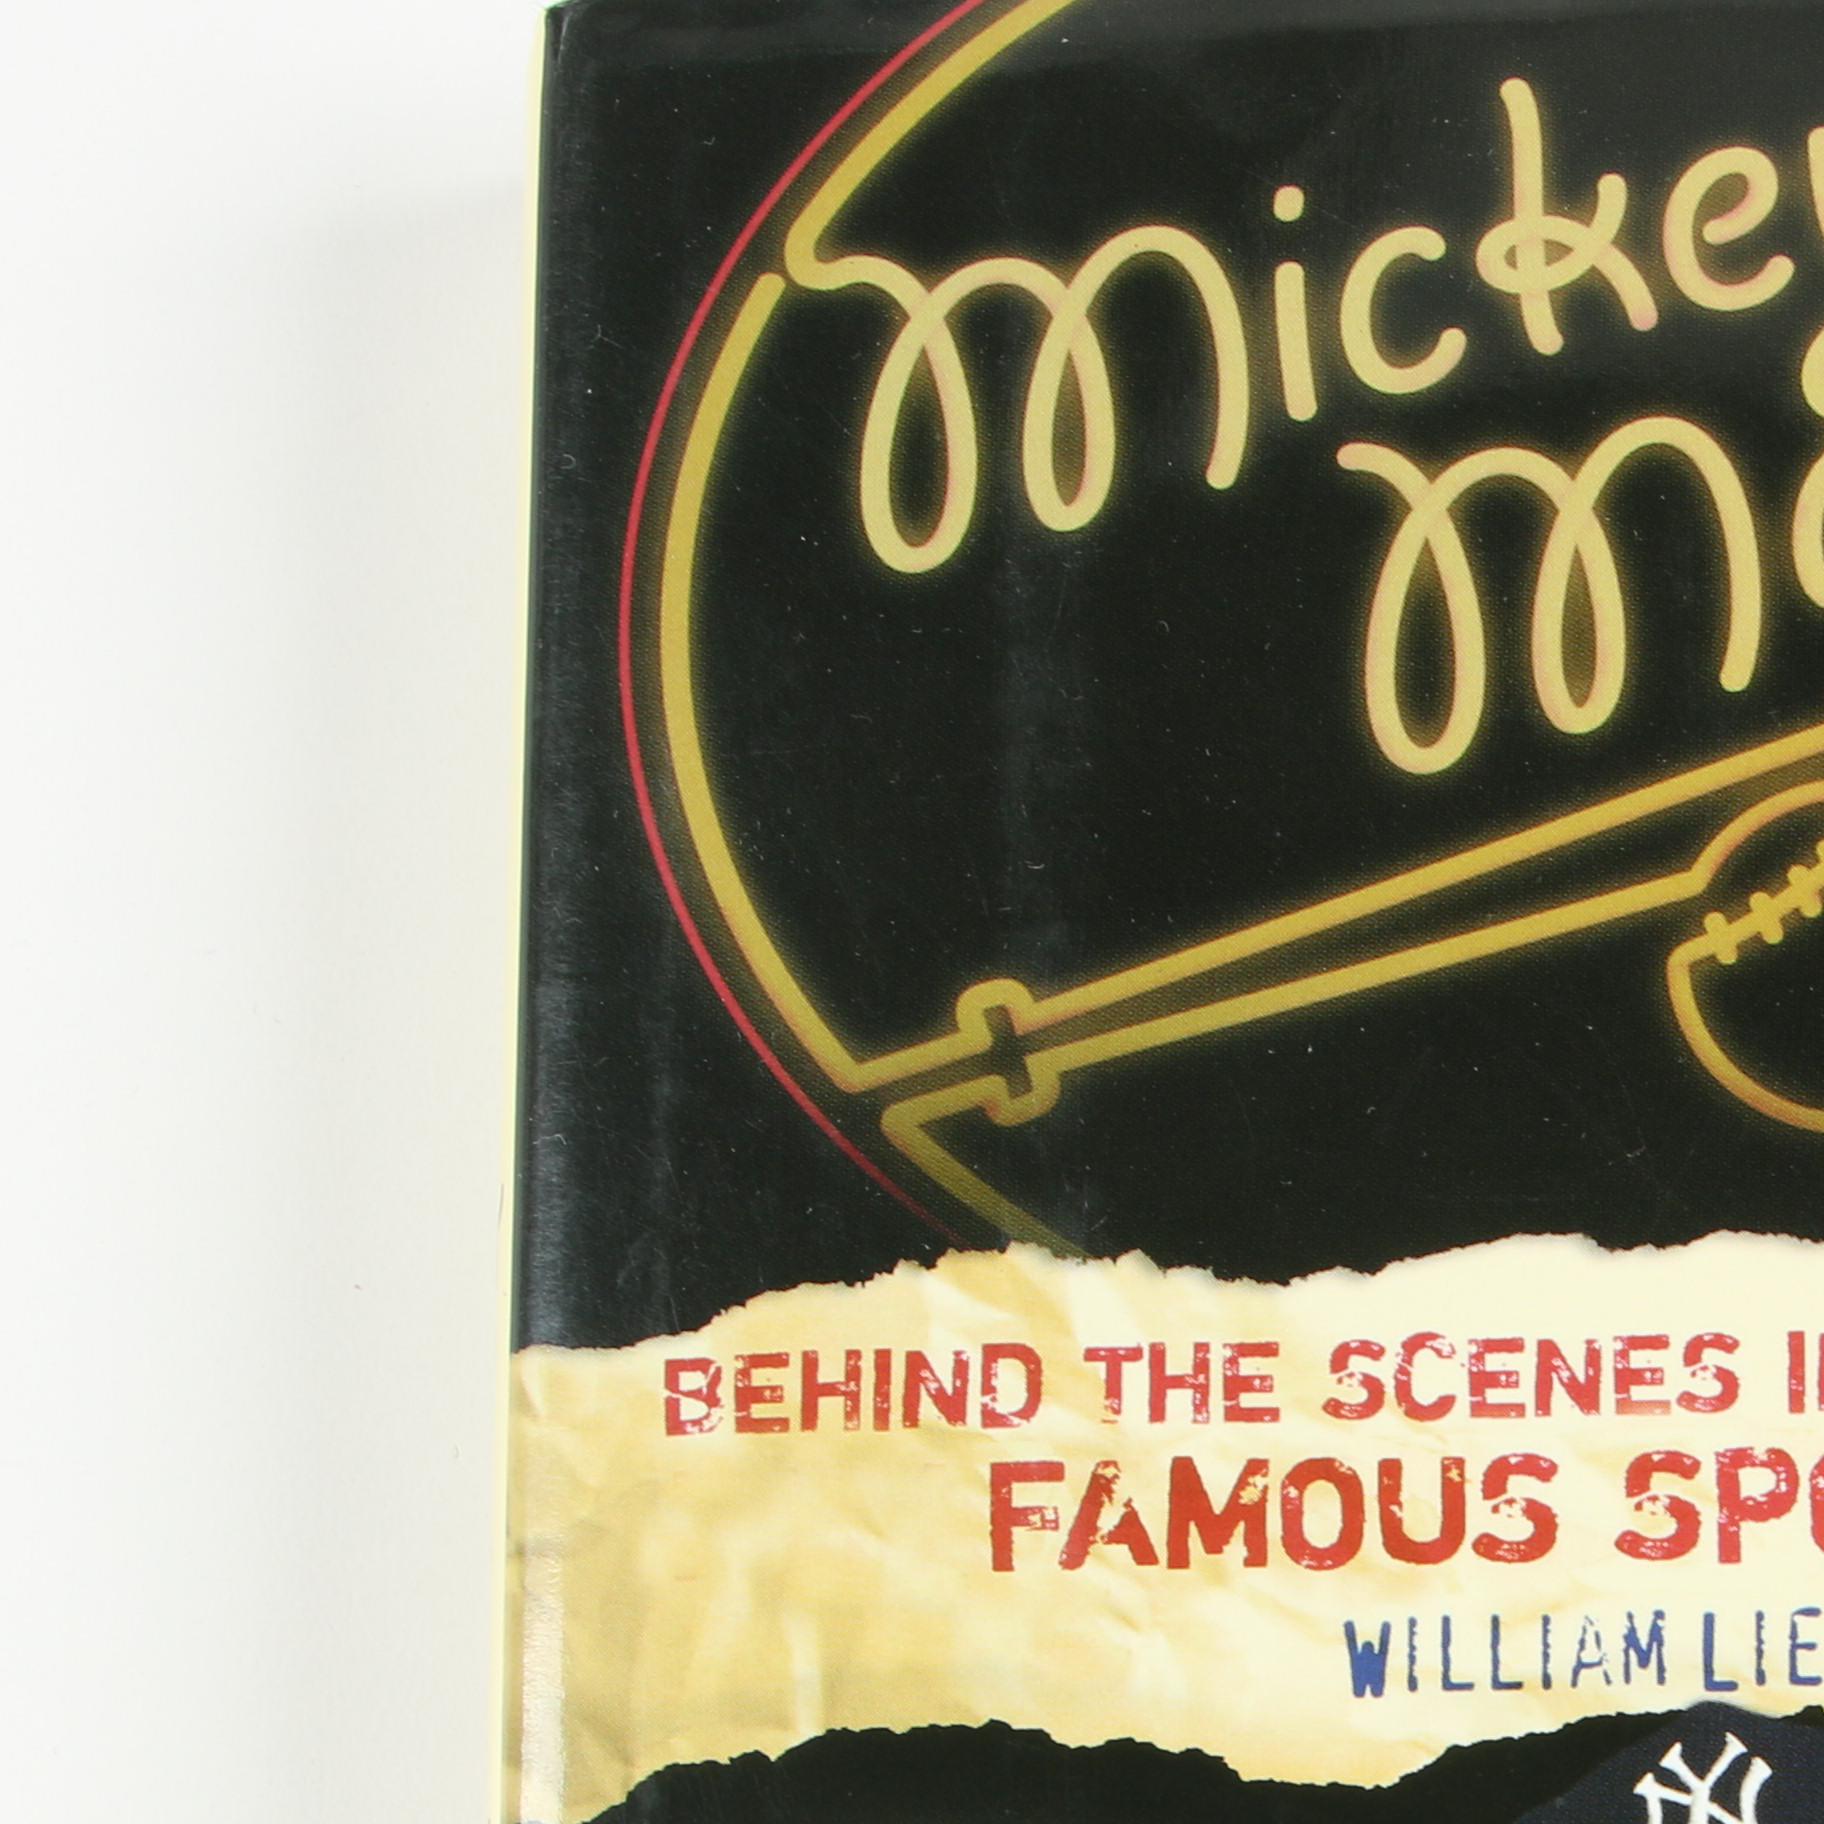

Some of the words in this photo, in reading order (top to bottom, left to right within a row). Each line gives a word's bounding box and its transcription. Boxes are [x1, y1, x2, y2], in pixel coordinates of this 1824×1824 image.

[664, 1342, 1045, 1438] BEHIND
[1082, 1340, 1282, 1425] THE
[1321, 1331, 1742, 1424] SCENES
[989, 1452, 1560, 1574] FAMOUS
[1343, 1609, 1669, 1698] WILLIAM
